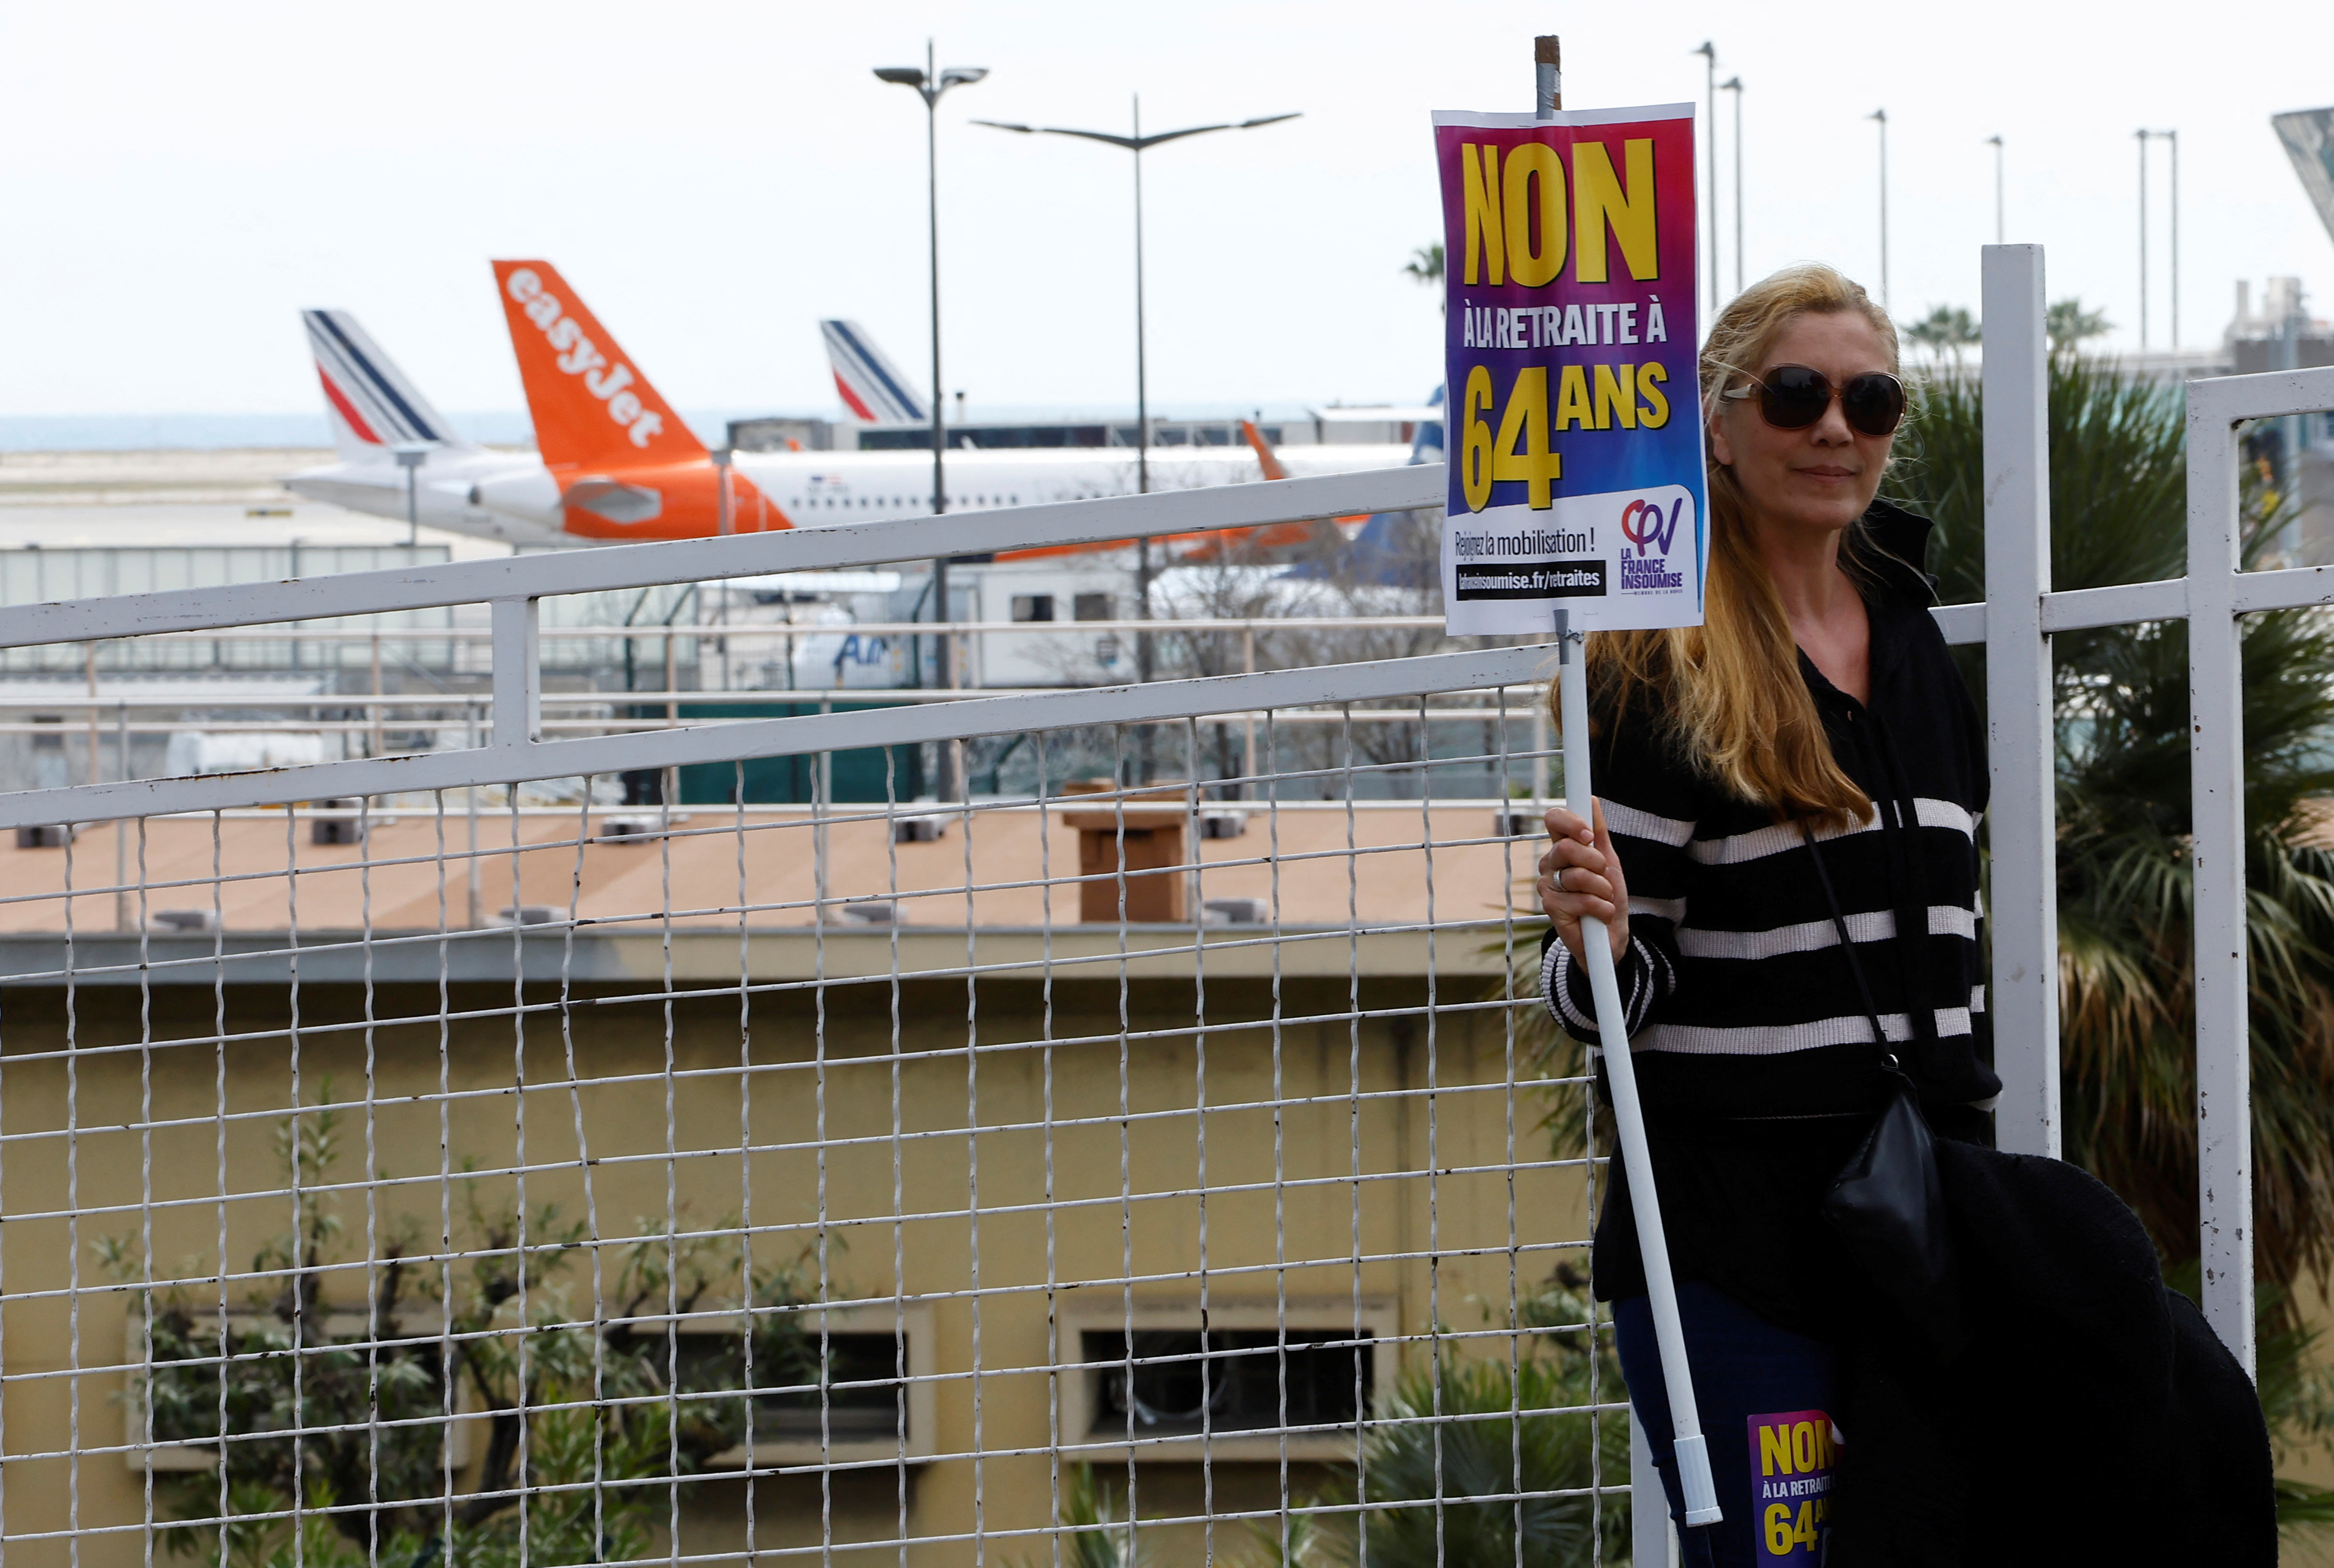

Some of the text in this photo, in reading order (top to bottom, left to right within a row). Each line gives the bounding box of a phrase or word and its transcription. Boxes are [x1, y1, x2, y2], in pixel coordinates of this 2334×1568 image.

[1462, 138, 1658, 287] NON
[1464, 295, 1667, 348] À LA RETRAITE À
[507, 268, 663, 448] easyJet
[1462, 361, 1670, 513] 64 ANS
[1486, 531, 1494, 555] la
[1497, 528, 1586, 556] mobilisation
[1590, 527, 1595, 552] !
[1621, 548, 1632, 560] LA
[1621, 559, 1665, 576] FRANCE
[1621, 572, 1682, 590] INSOUMISE
[1759, 1419, 1835, 1477] NON
[1762, 1480, 1772, 1499] À
[1773, 1482, 1788, 1498] LA
[1790, 1475, 1831, 1497] RETRAITE
[1764, 1500, 1818, 1556] 64
